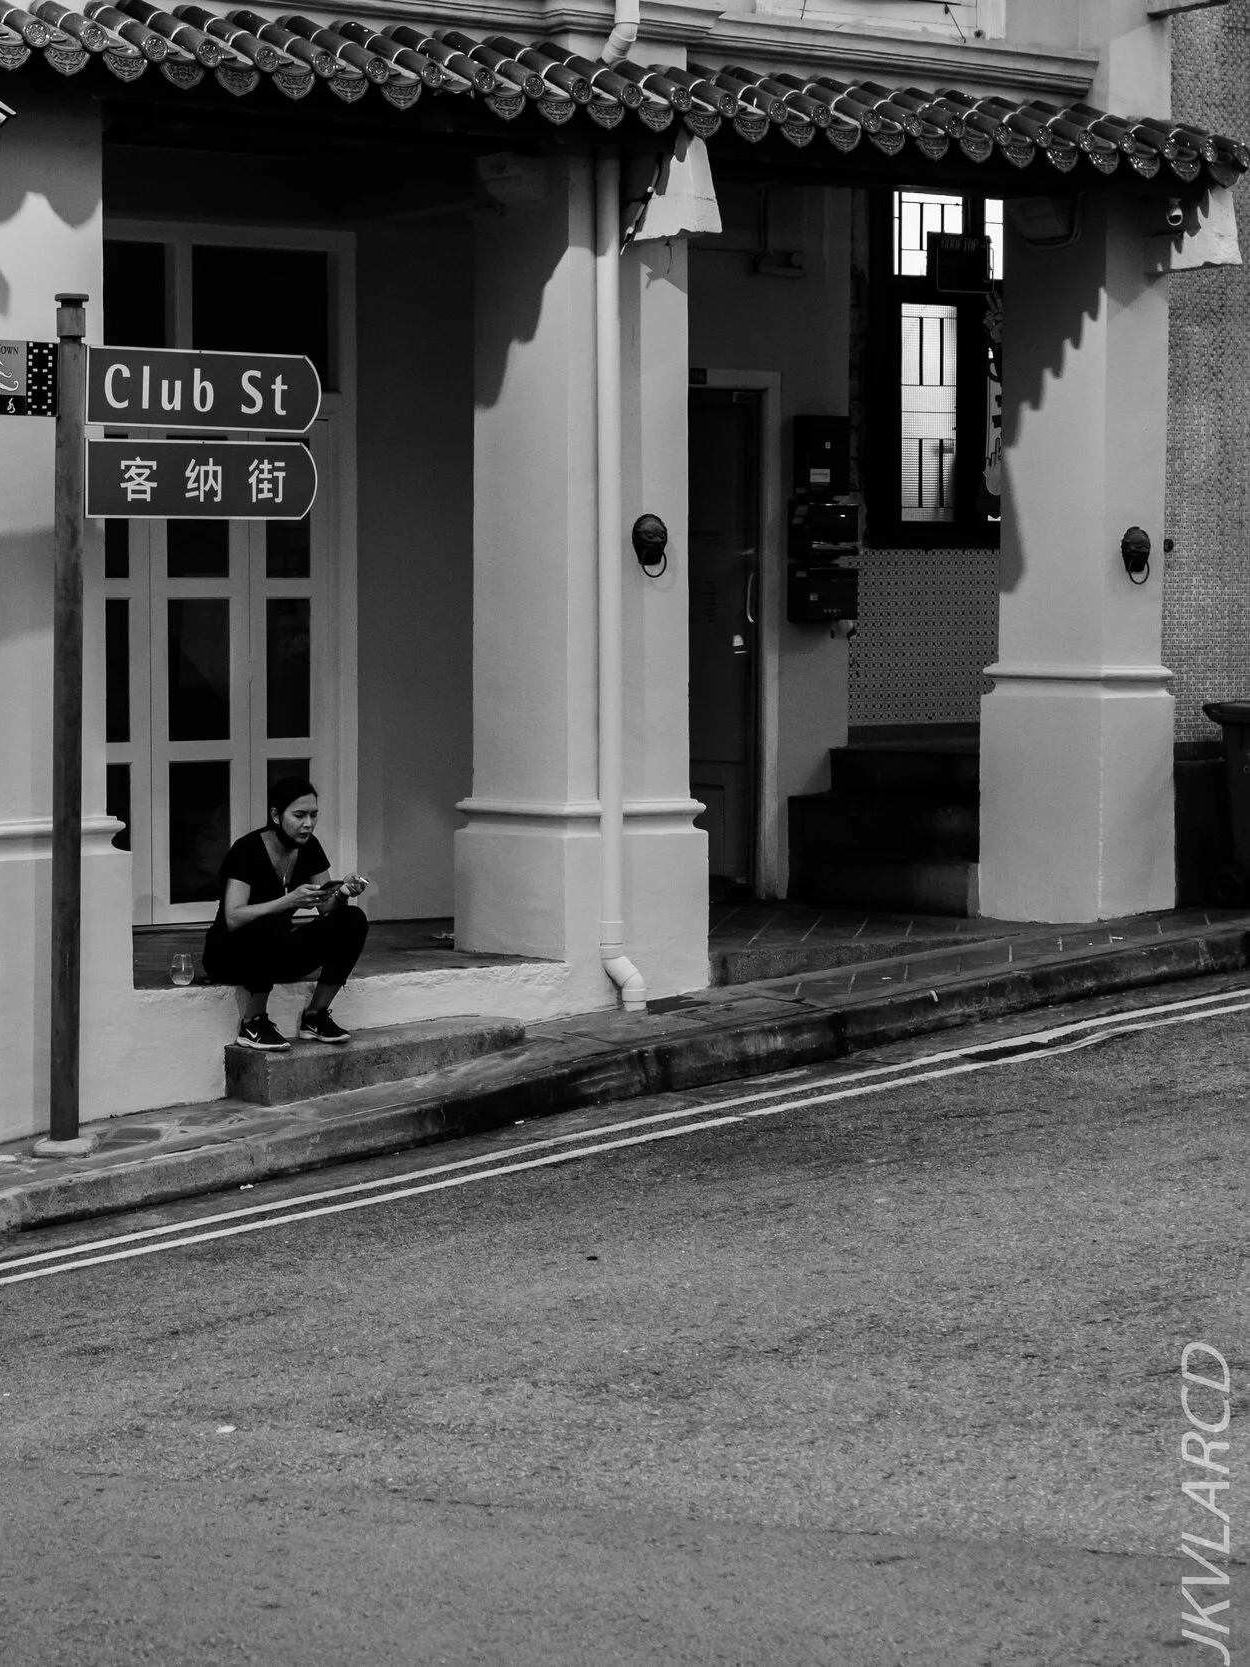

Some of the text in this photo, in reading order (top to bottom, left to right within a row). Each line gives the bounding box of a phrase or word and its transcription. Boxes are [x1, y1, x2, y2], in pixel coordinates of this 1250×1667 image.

[104, 363, 288, 416] Club St
[119, 456, 286, 503] 客纳街
